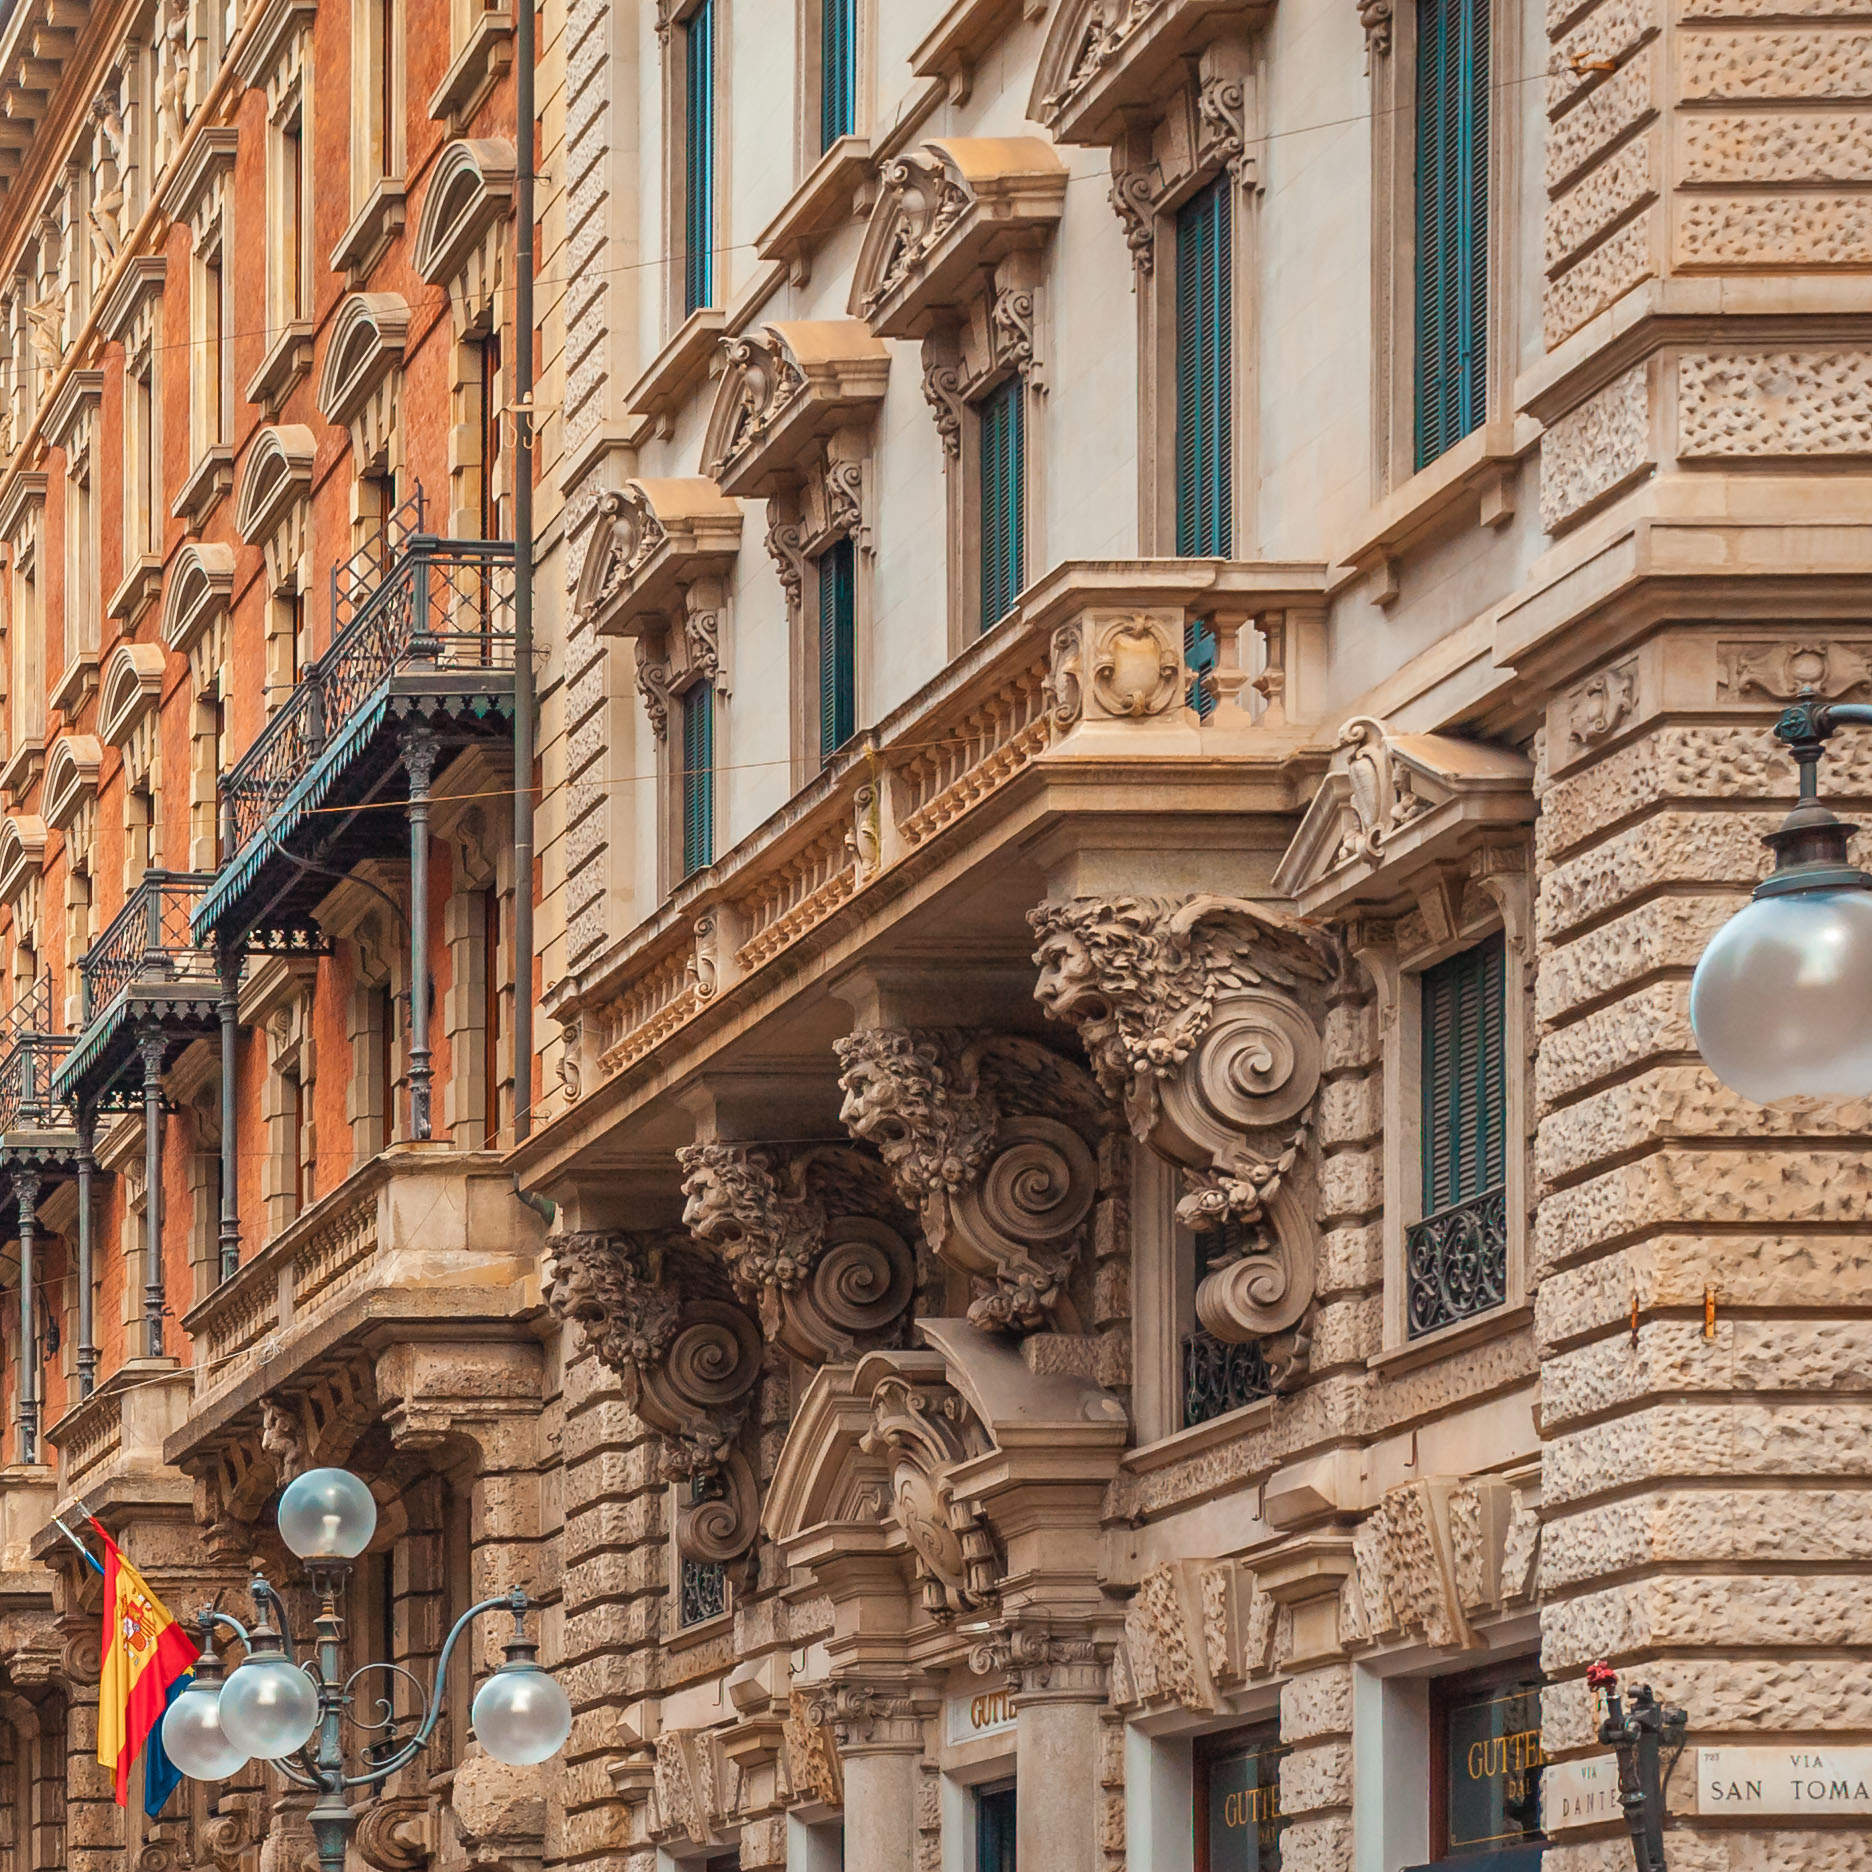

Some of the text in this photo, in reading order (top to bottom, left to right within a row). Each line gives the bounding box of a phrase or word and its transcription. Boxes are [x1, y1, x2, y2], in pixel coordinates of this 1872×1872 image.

[1790, 1755, 1823, 1768] VIA
[1581, 1767, 1598, 1779] VIA
[1711, 1780, 1871, 1800] SAN TOMA
[1562, 1789, 1616, 1818] DANTE
